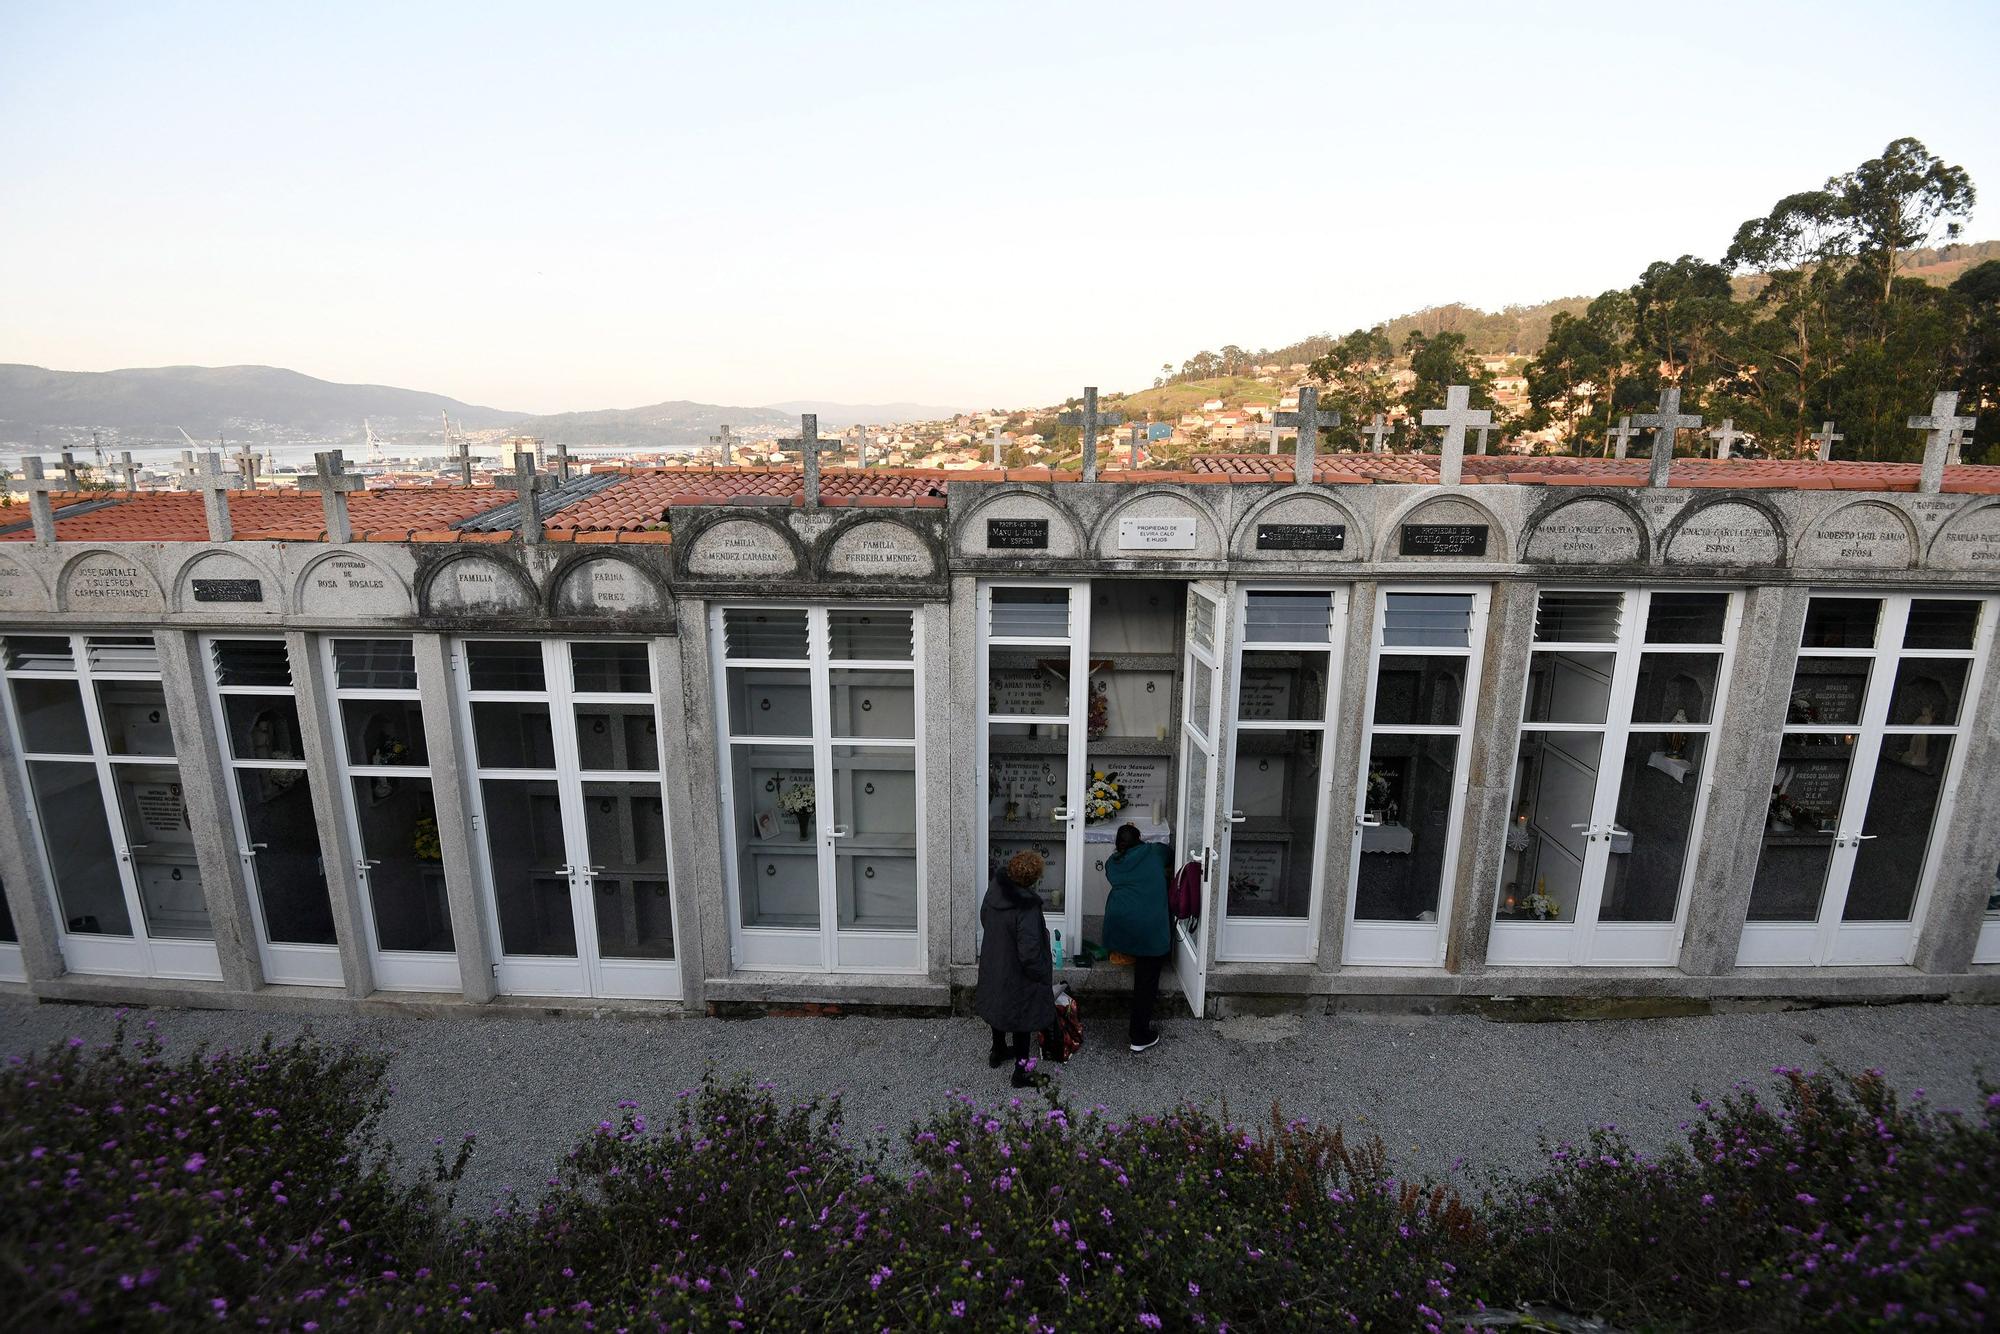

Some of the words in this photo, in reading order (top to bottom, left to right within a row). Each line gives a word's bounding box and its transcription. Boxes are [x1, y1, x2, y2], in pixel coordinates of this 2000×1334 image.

[1415, 535, 1440, 543] CIRILO
[1817, 531, 1854, 539] MODESTO
[709, 552, 740, 560] MENDEZ
[459, 574, 493, 582] FAMILIA
[318, 580, 338, 588] ROSA
[349, 580, 384, 588] ROSALES
